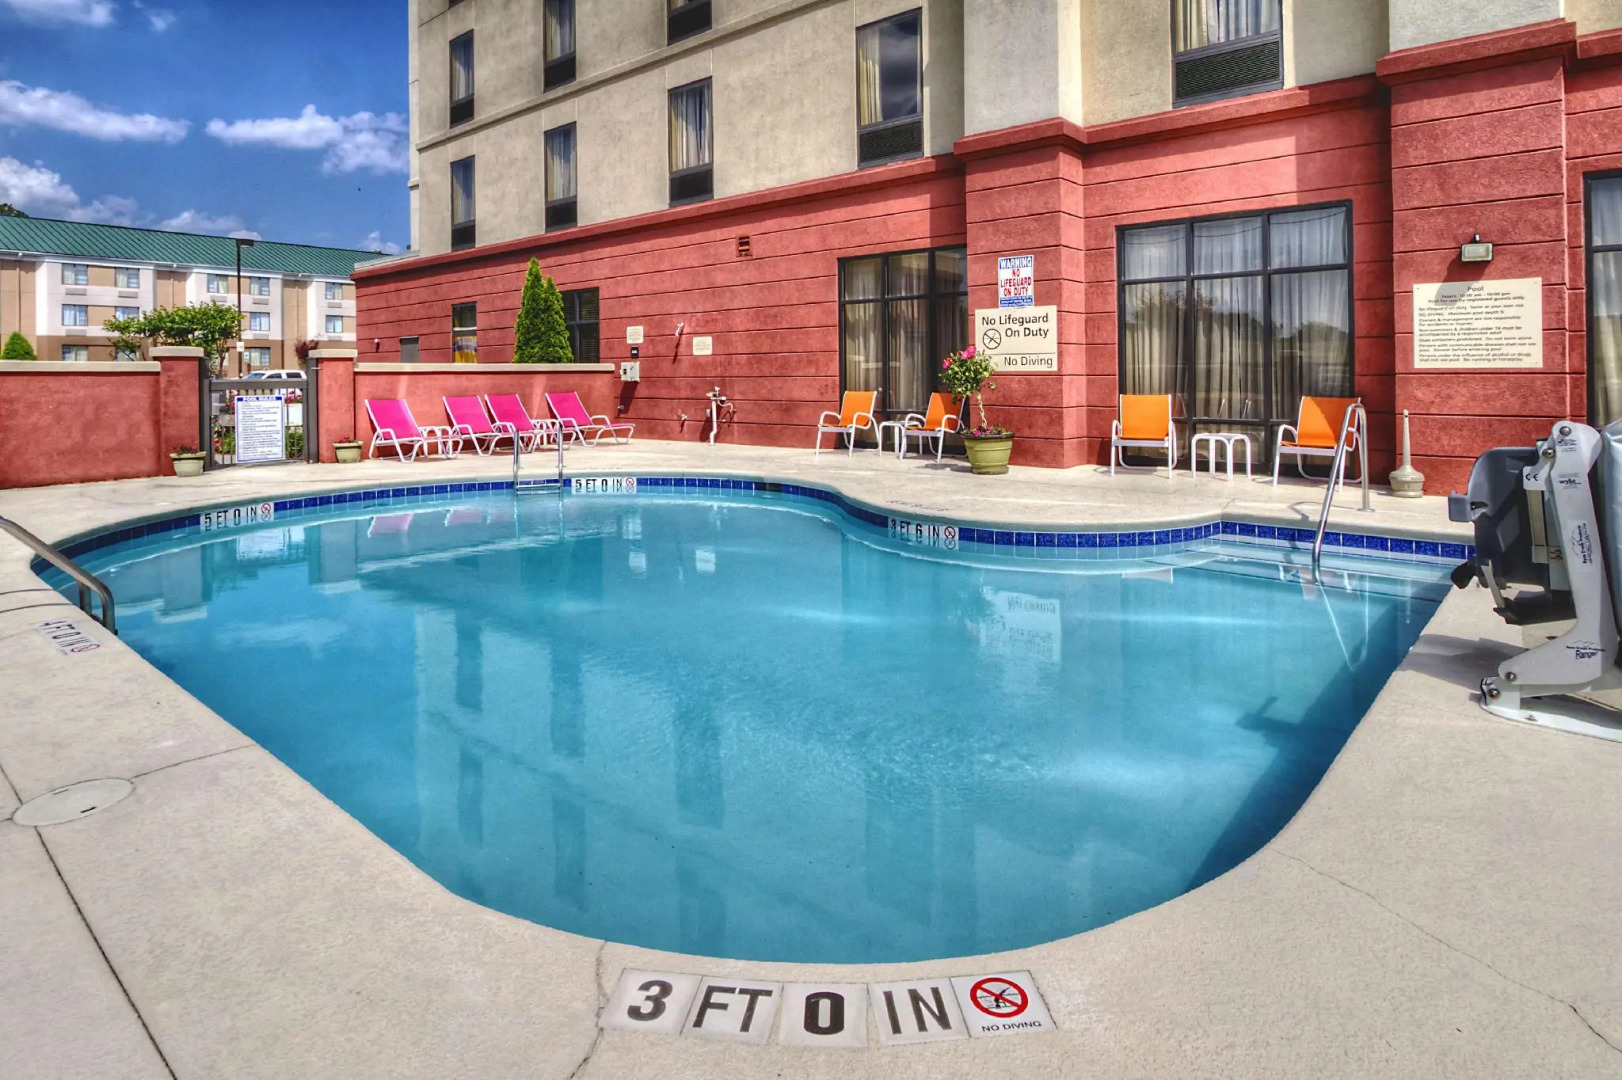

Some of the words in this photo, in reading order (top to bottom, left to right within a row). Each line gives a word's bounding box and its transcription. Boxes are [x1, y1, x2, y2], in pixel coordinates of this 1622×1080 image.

[1000, 256, 1032, 269] WARNING
[1000, 277, 1032, 288] LIFEGUARD
[1004, 288, 1012, 296] ON
[1014, 286, 1028, 296] DUTY
[982, 316, 996, 326] No
[999, 312, 1048, 326] Lifeguard
[1005, 328, 1020, 337] On
[1024, 328, 1049, 338] Duty
[1004, 356, 1018, 366] No
[1020, 356, 1052, 368] Diving
[586, 478, 597, 489] FT
[612, 478, 622, 489] IN
[204, 513, 211, 527] 5
[216, 510, 228, 525] FT
[234, 508, 240, 521] 0
[246, 506, 257, 520] IN
[900, 521, 911, 537] FT
[916, 523, 922, 539] 6
[928, 525, 940, 541] IN
[1576, 650, 1598, 660] Ranger
[627, 980, 673, 1021] 3
[692, 985, 773, 1032] FT
[804, 992, 844, 1035] 0
[883, 986, 952, 1034] IN
[982, 1024, 1000, 1032] NO
[1003, 1020, 1042, 1030] DIVING
